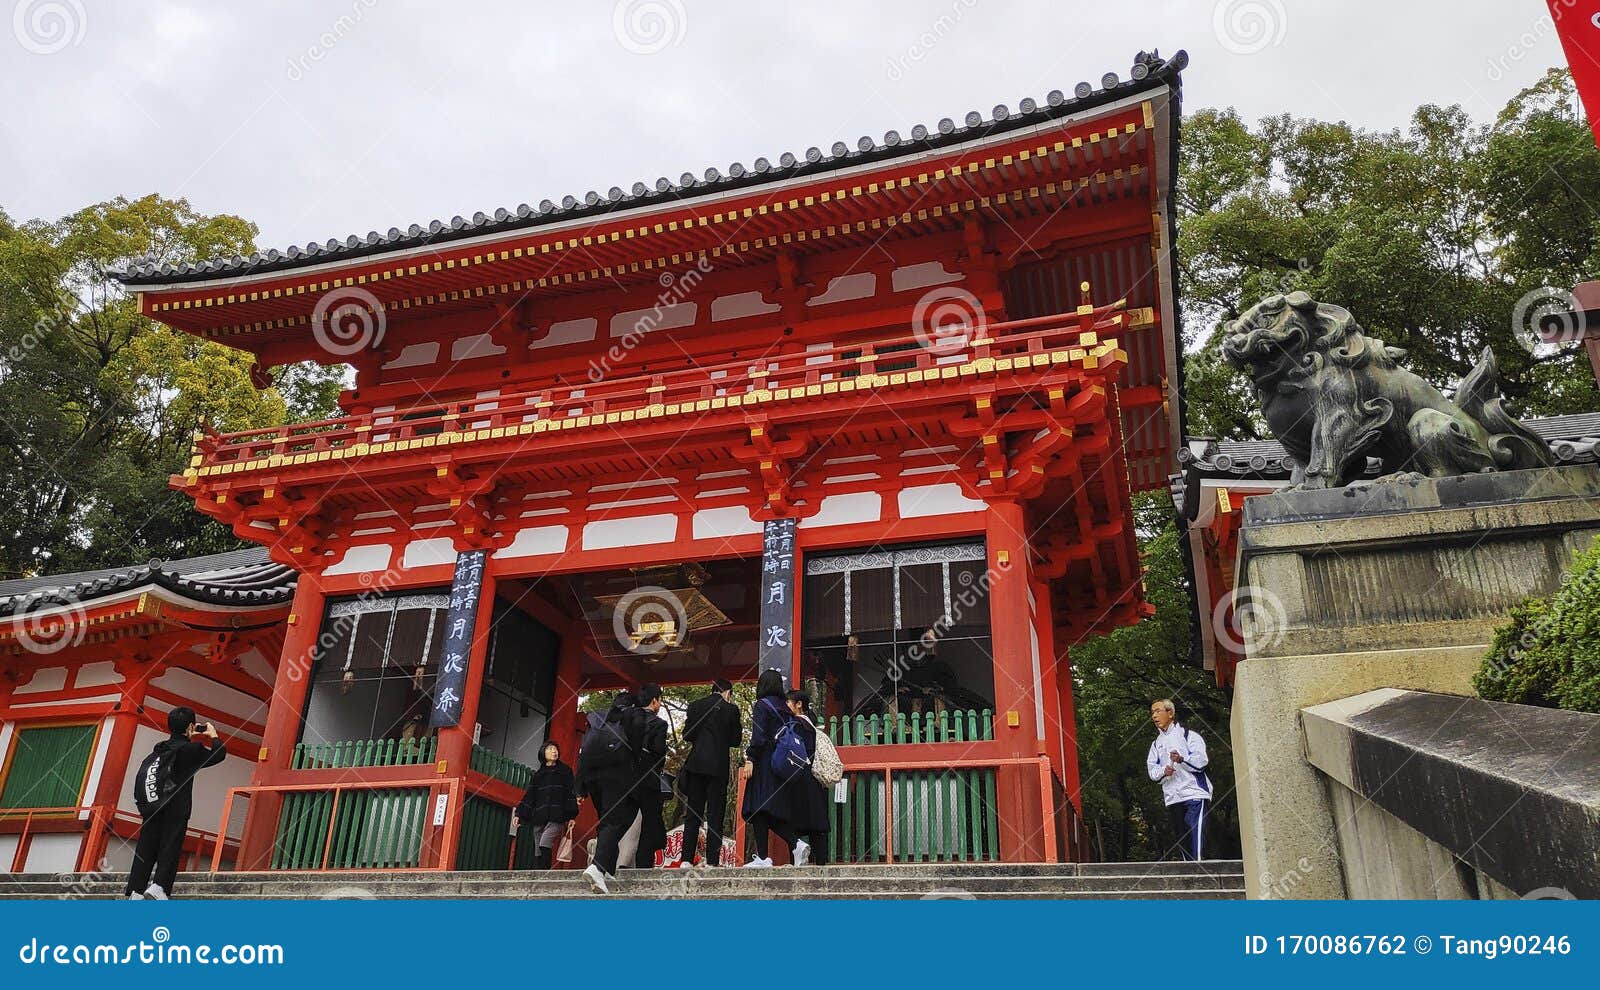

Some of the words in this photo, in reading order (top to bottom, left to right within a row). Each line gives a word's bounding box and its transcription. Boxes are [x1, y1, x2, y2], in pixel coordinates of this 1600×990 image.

[763, 521, 779, 574] 午前十時
[778, 520, 793, 569] 十二月一日
[450, 553, 469, 611] 午前十時
[463, 552, 483, 609] 十二月十五日
[766, 581, 788, 682] 月次
[435, 618, 467, 713] 月次祭
